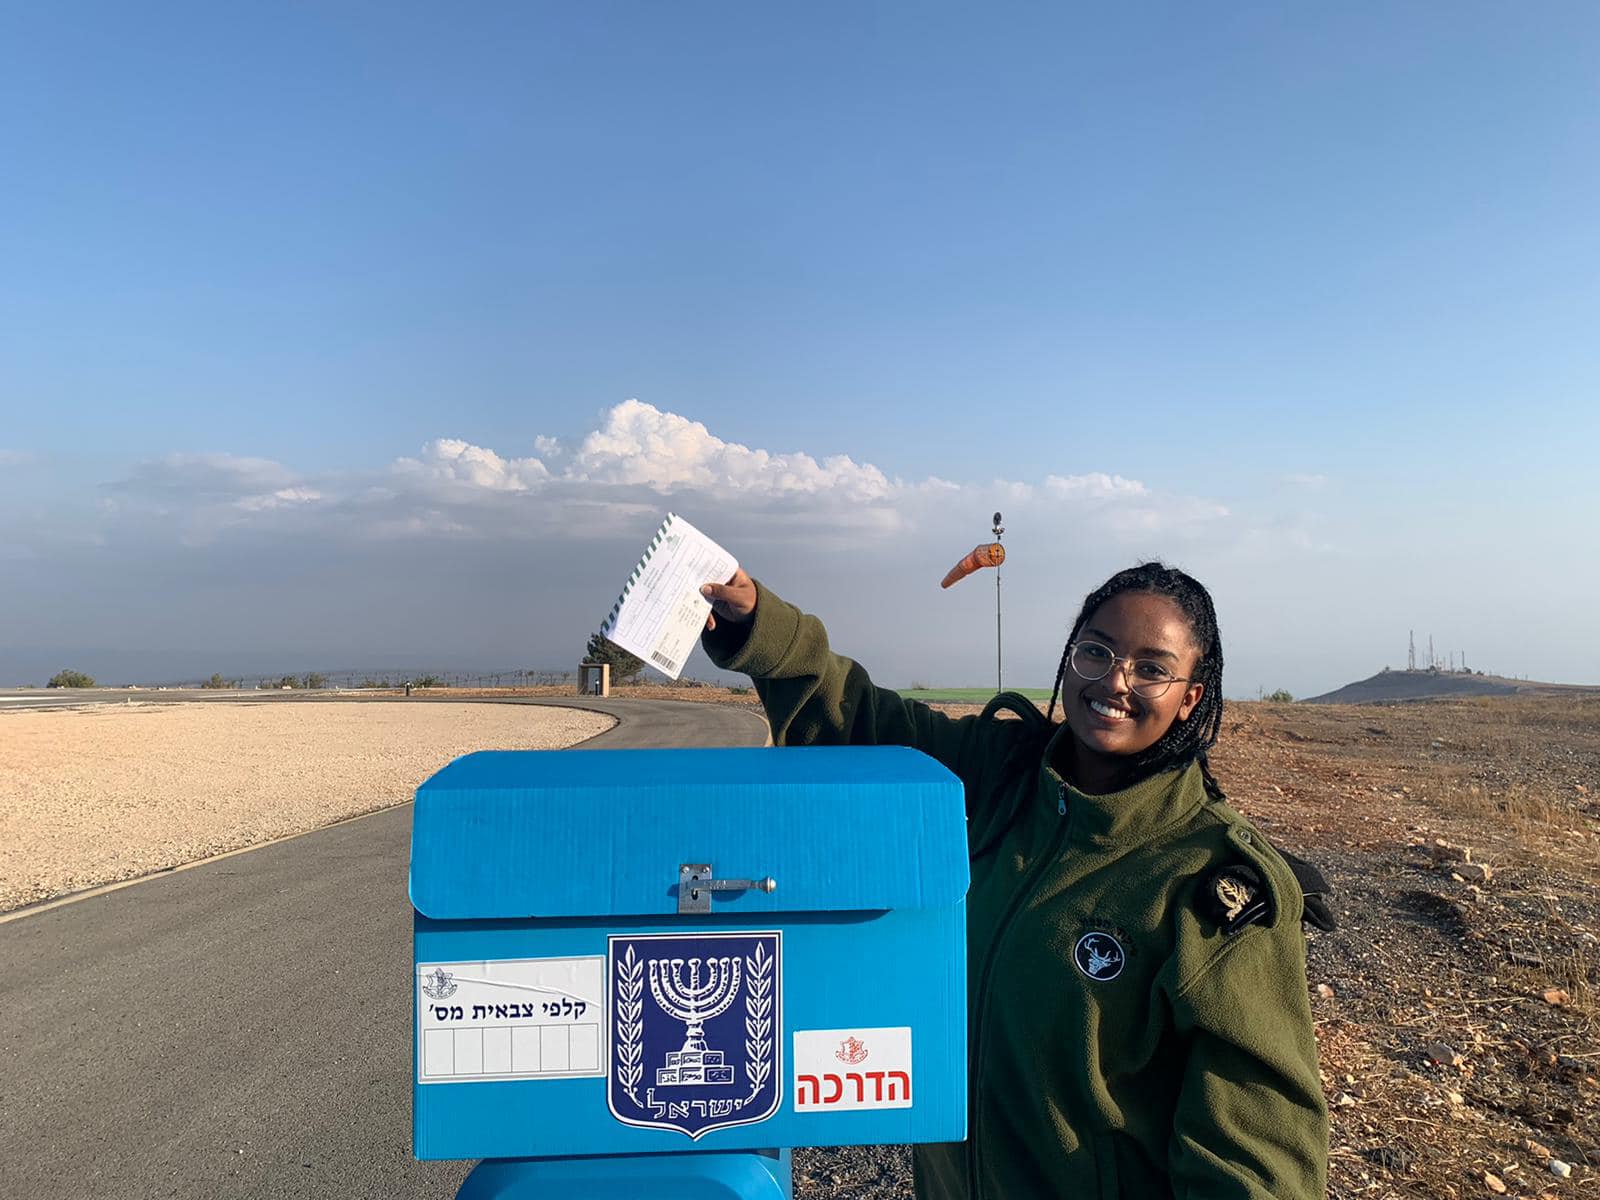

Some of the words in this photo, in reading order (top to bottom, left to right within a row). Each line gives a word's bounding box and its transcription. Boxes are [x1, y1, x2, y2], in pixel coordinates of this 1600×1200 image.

[472, 1002, 533, 1020] צבאית
[542, 997, 587, 1020] קלפי
[797, 1070, 911, 1105] הדרכה
[646, 1087, 743, 1119] ישראל
